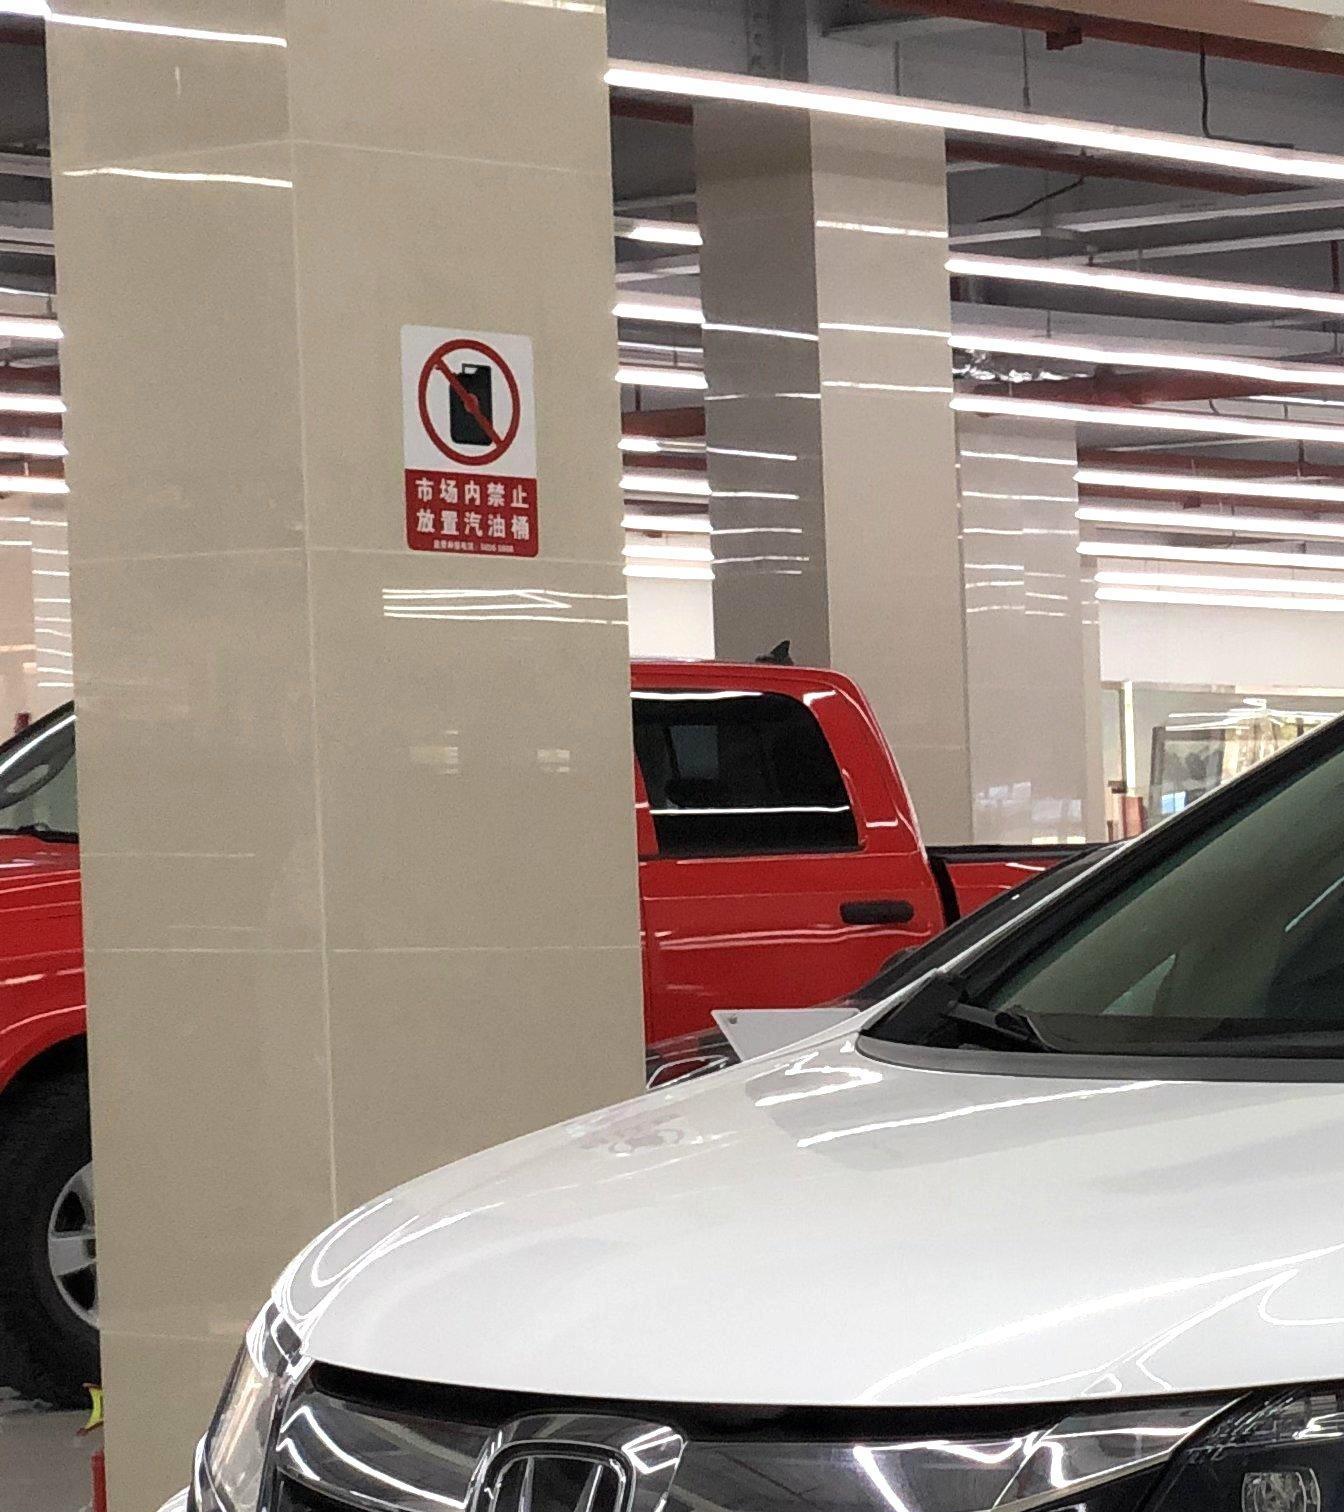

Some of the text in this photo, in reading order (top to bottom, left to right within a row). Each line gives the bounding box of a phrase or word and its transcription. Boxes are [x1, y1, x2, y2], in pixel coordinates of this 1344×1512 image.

[415, 477, 530, 508] 市场内禁止
[416, 508, 530, 540] 放置汽油桶
